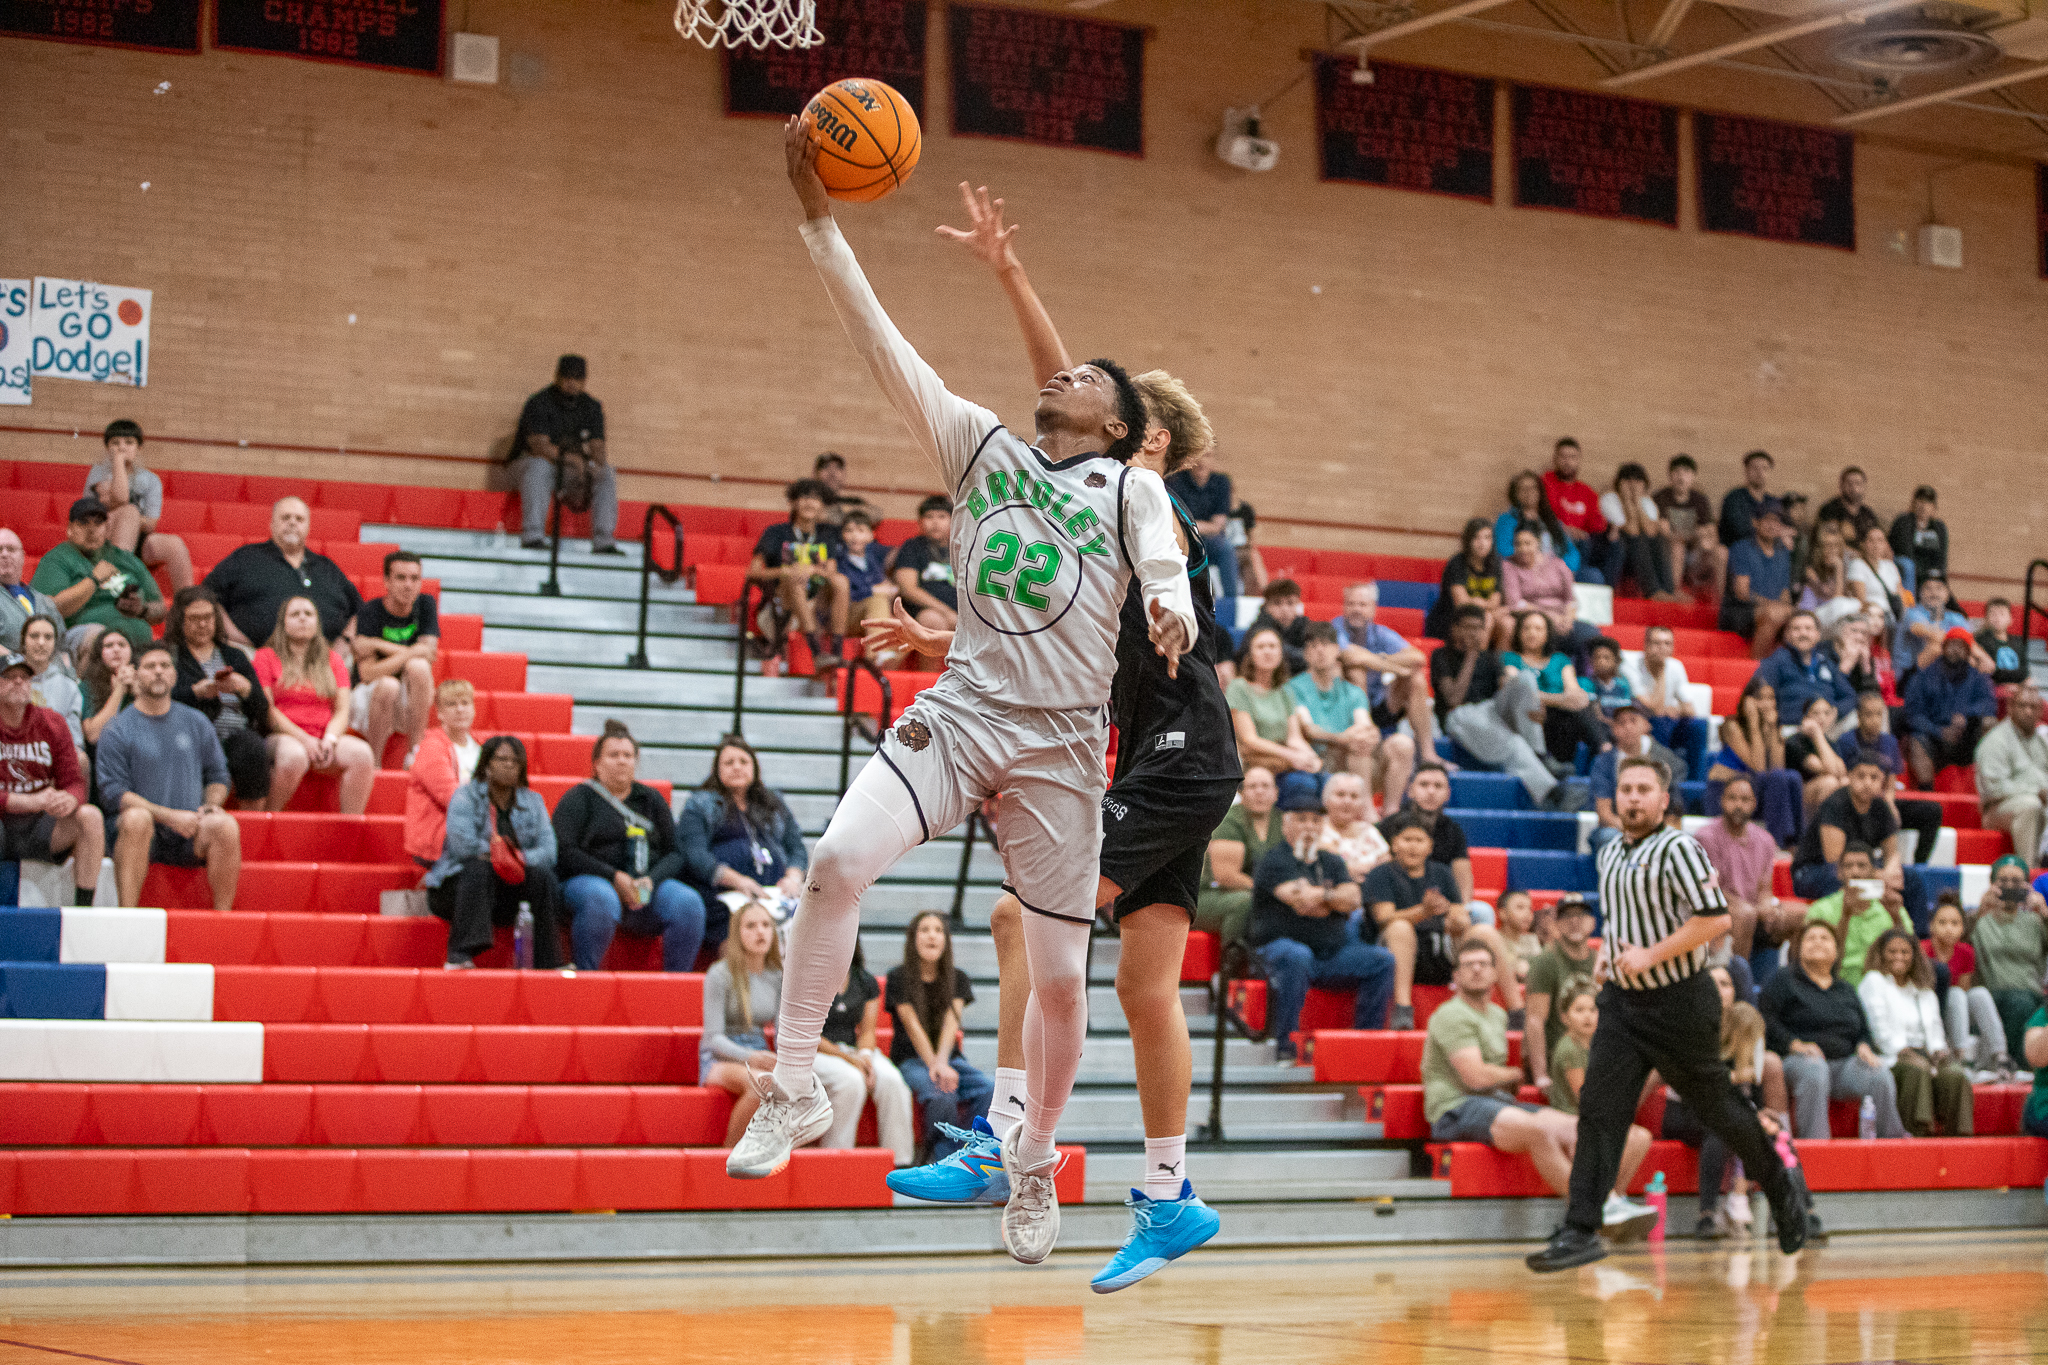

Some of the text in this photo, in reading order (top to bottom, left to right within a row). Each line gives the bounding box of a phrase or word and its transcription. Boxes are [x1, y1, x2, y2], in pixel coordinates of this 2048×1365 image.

[51, 9, 114, 38] 1982
[263, 0, 397, 37] CHAMPS
[298, 28, 359, 57] 1982
[40, 282, 109, 311] Let's
[59, 311, 112, 340] GO
[32, 336, 142, 389] Dodge!
[975, 529, 1063, 613] 22
